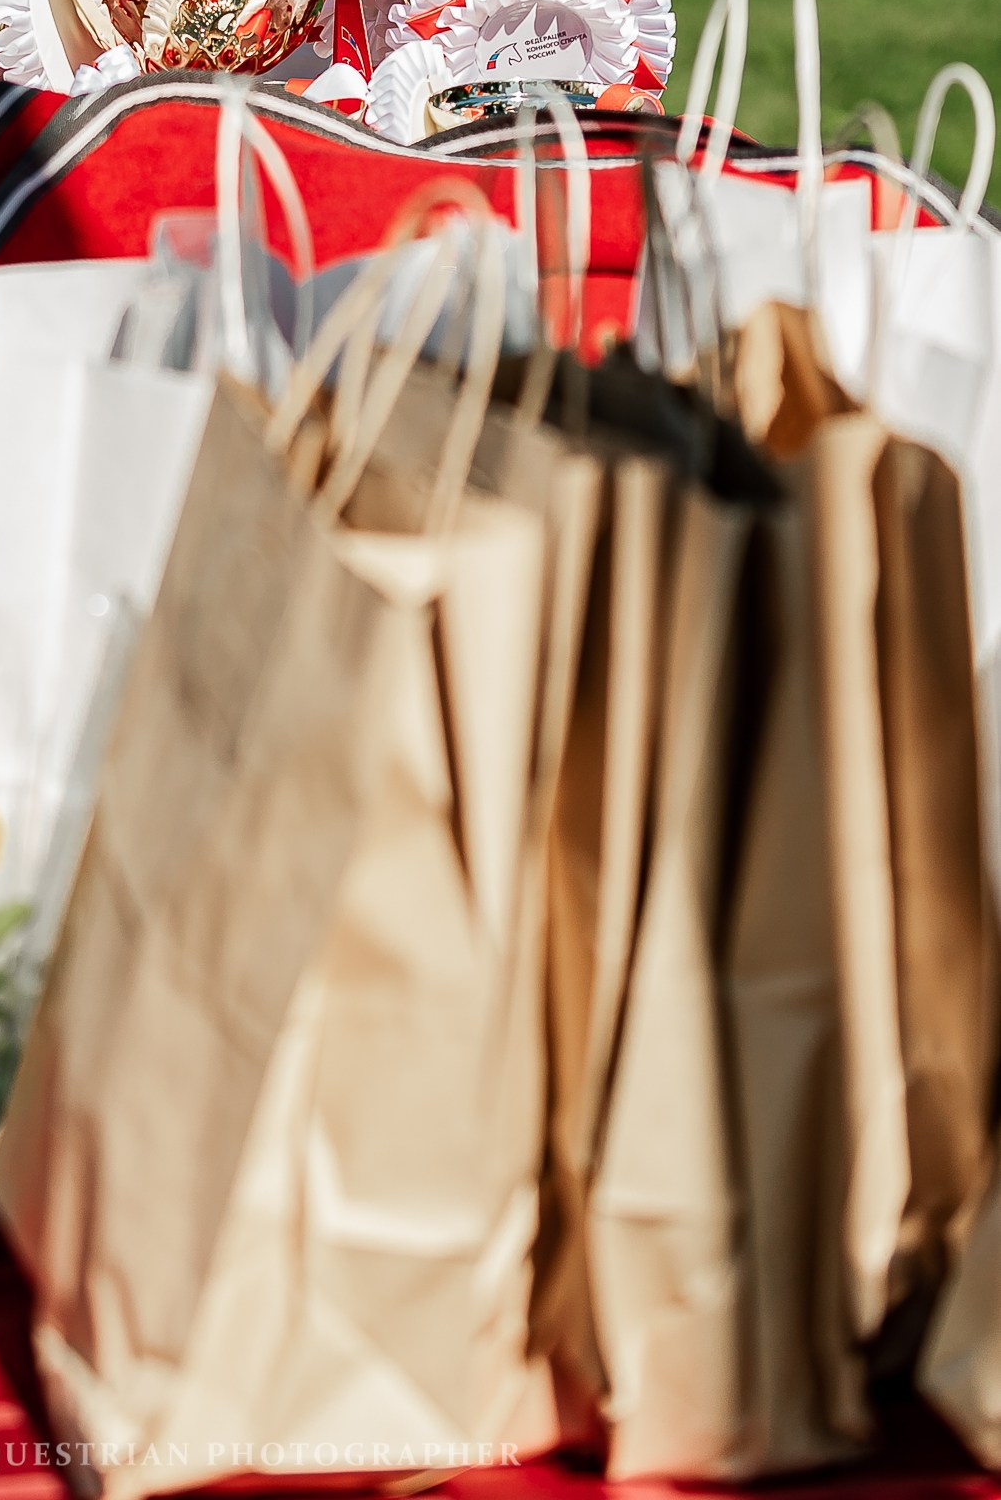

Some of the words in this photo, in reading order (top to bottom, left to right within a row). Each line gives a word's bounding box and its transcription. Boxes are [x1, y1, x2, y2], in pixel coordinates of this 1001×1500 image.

[524, 31, 567, 46] ФЕДЕРАЦИЯ
[526, 40, 560, 53] КОННОГО
[560, 33, 588, 45] СПОРТА
[527, 49, 557, 60] РОССИИ
